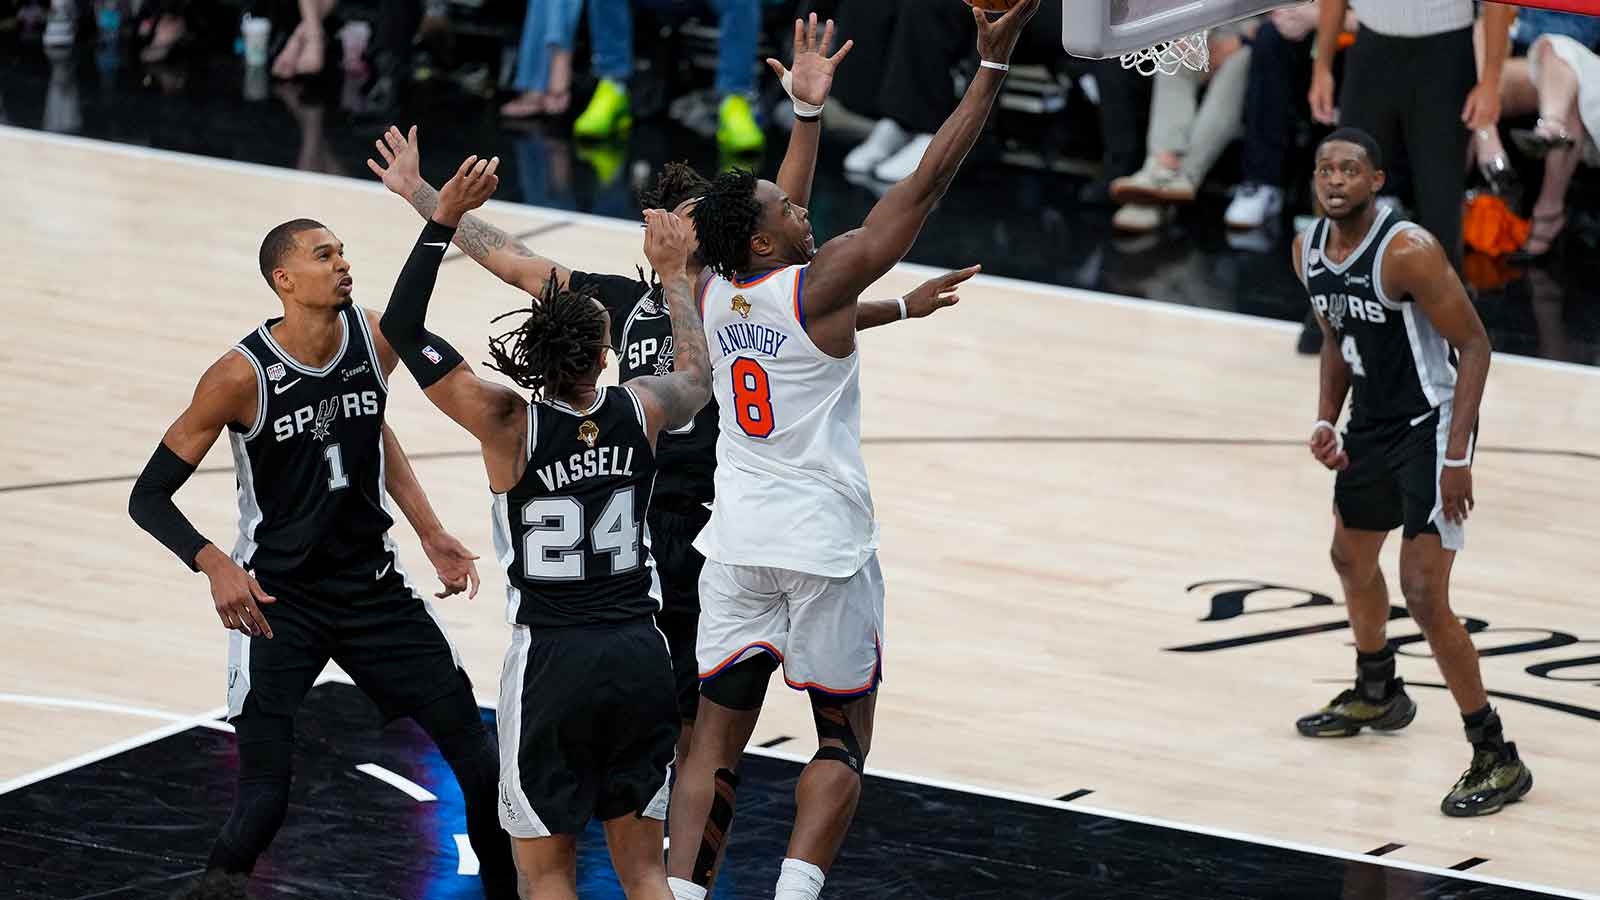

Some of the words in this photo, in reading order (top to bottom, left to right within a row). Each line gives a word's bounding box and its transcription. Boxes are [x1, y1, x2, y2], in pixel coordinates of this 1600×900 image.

[1310, 293, 1387, 330] PURS
[716, 322, 788, 358] ANUNOBY
[1341, 335, 1367, 378] 4
[730, 355, 775, 439] 8
[324, 443, 350, 492] 1
[536, 446, 634, 492] VASSELL
[521, 485, 640, 581] 24
